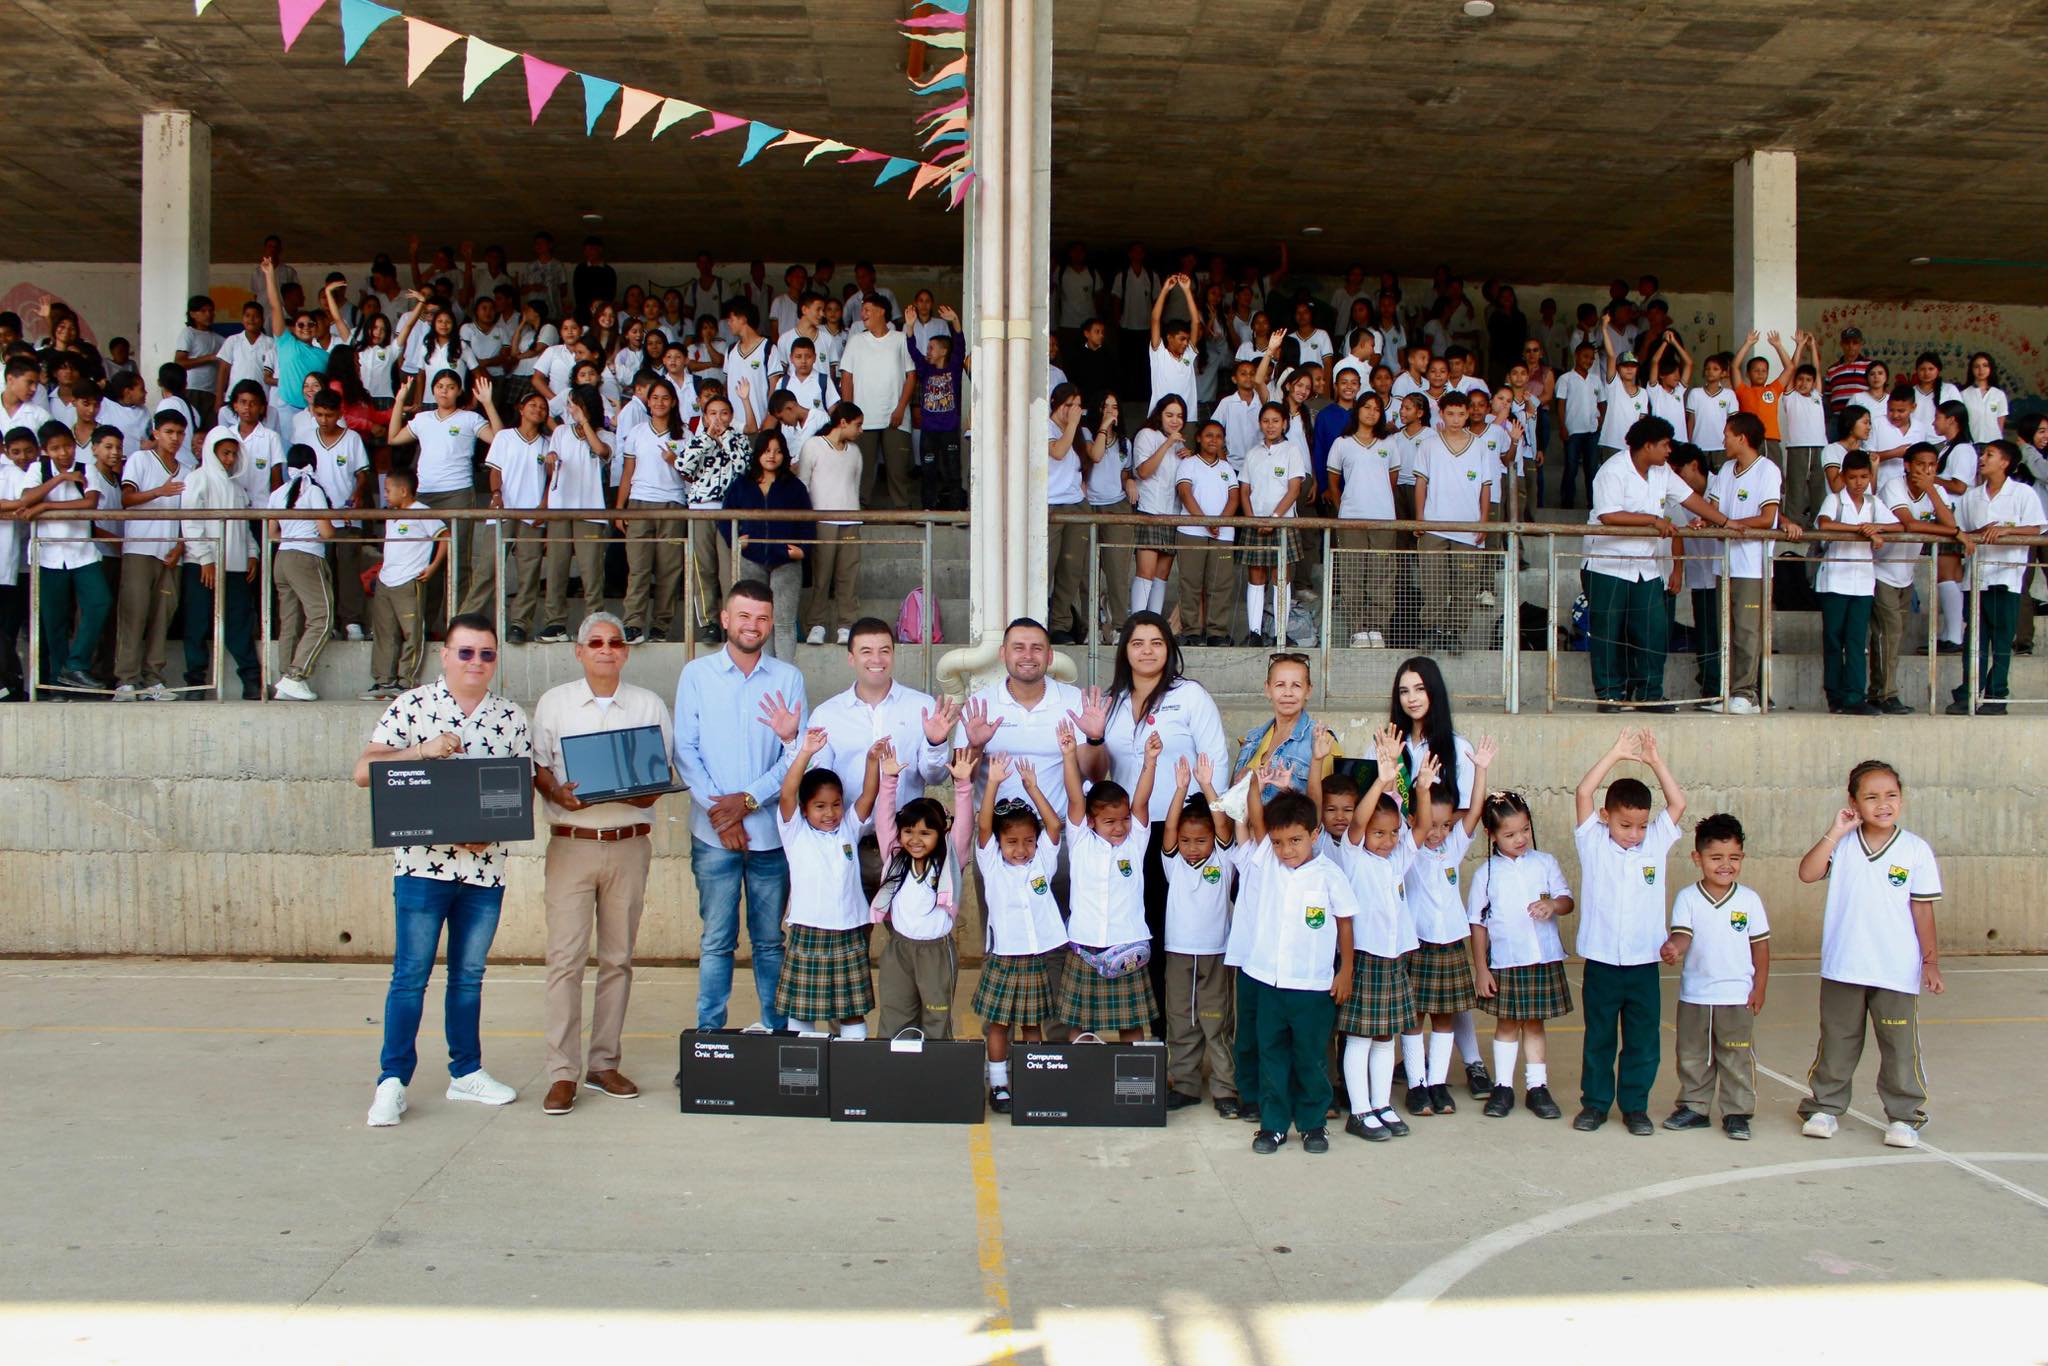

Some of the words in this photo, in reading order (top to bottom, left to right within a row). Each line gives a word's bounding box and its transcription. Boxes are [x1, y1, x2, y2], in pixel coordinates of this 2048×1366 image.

[387, 770, 426, 778] Compumax
[387, 778, 406, 786] Onix
[694, 1042, 729, 1050] Compumax
[694, 1050, 711, 1058] Onix
[713, 1051, 735, 1059] Series
[1026, 1053, 1063, 1062] Compumax
[1026, 1061, 1043, 1069] Onix
[1046, 1061, 1068, 1070] Series
